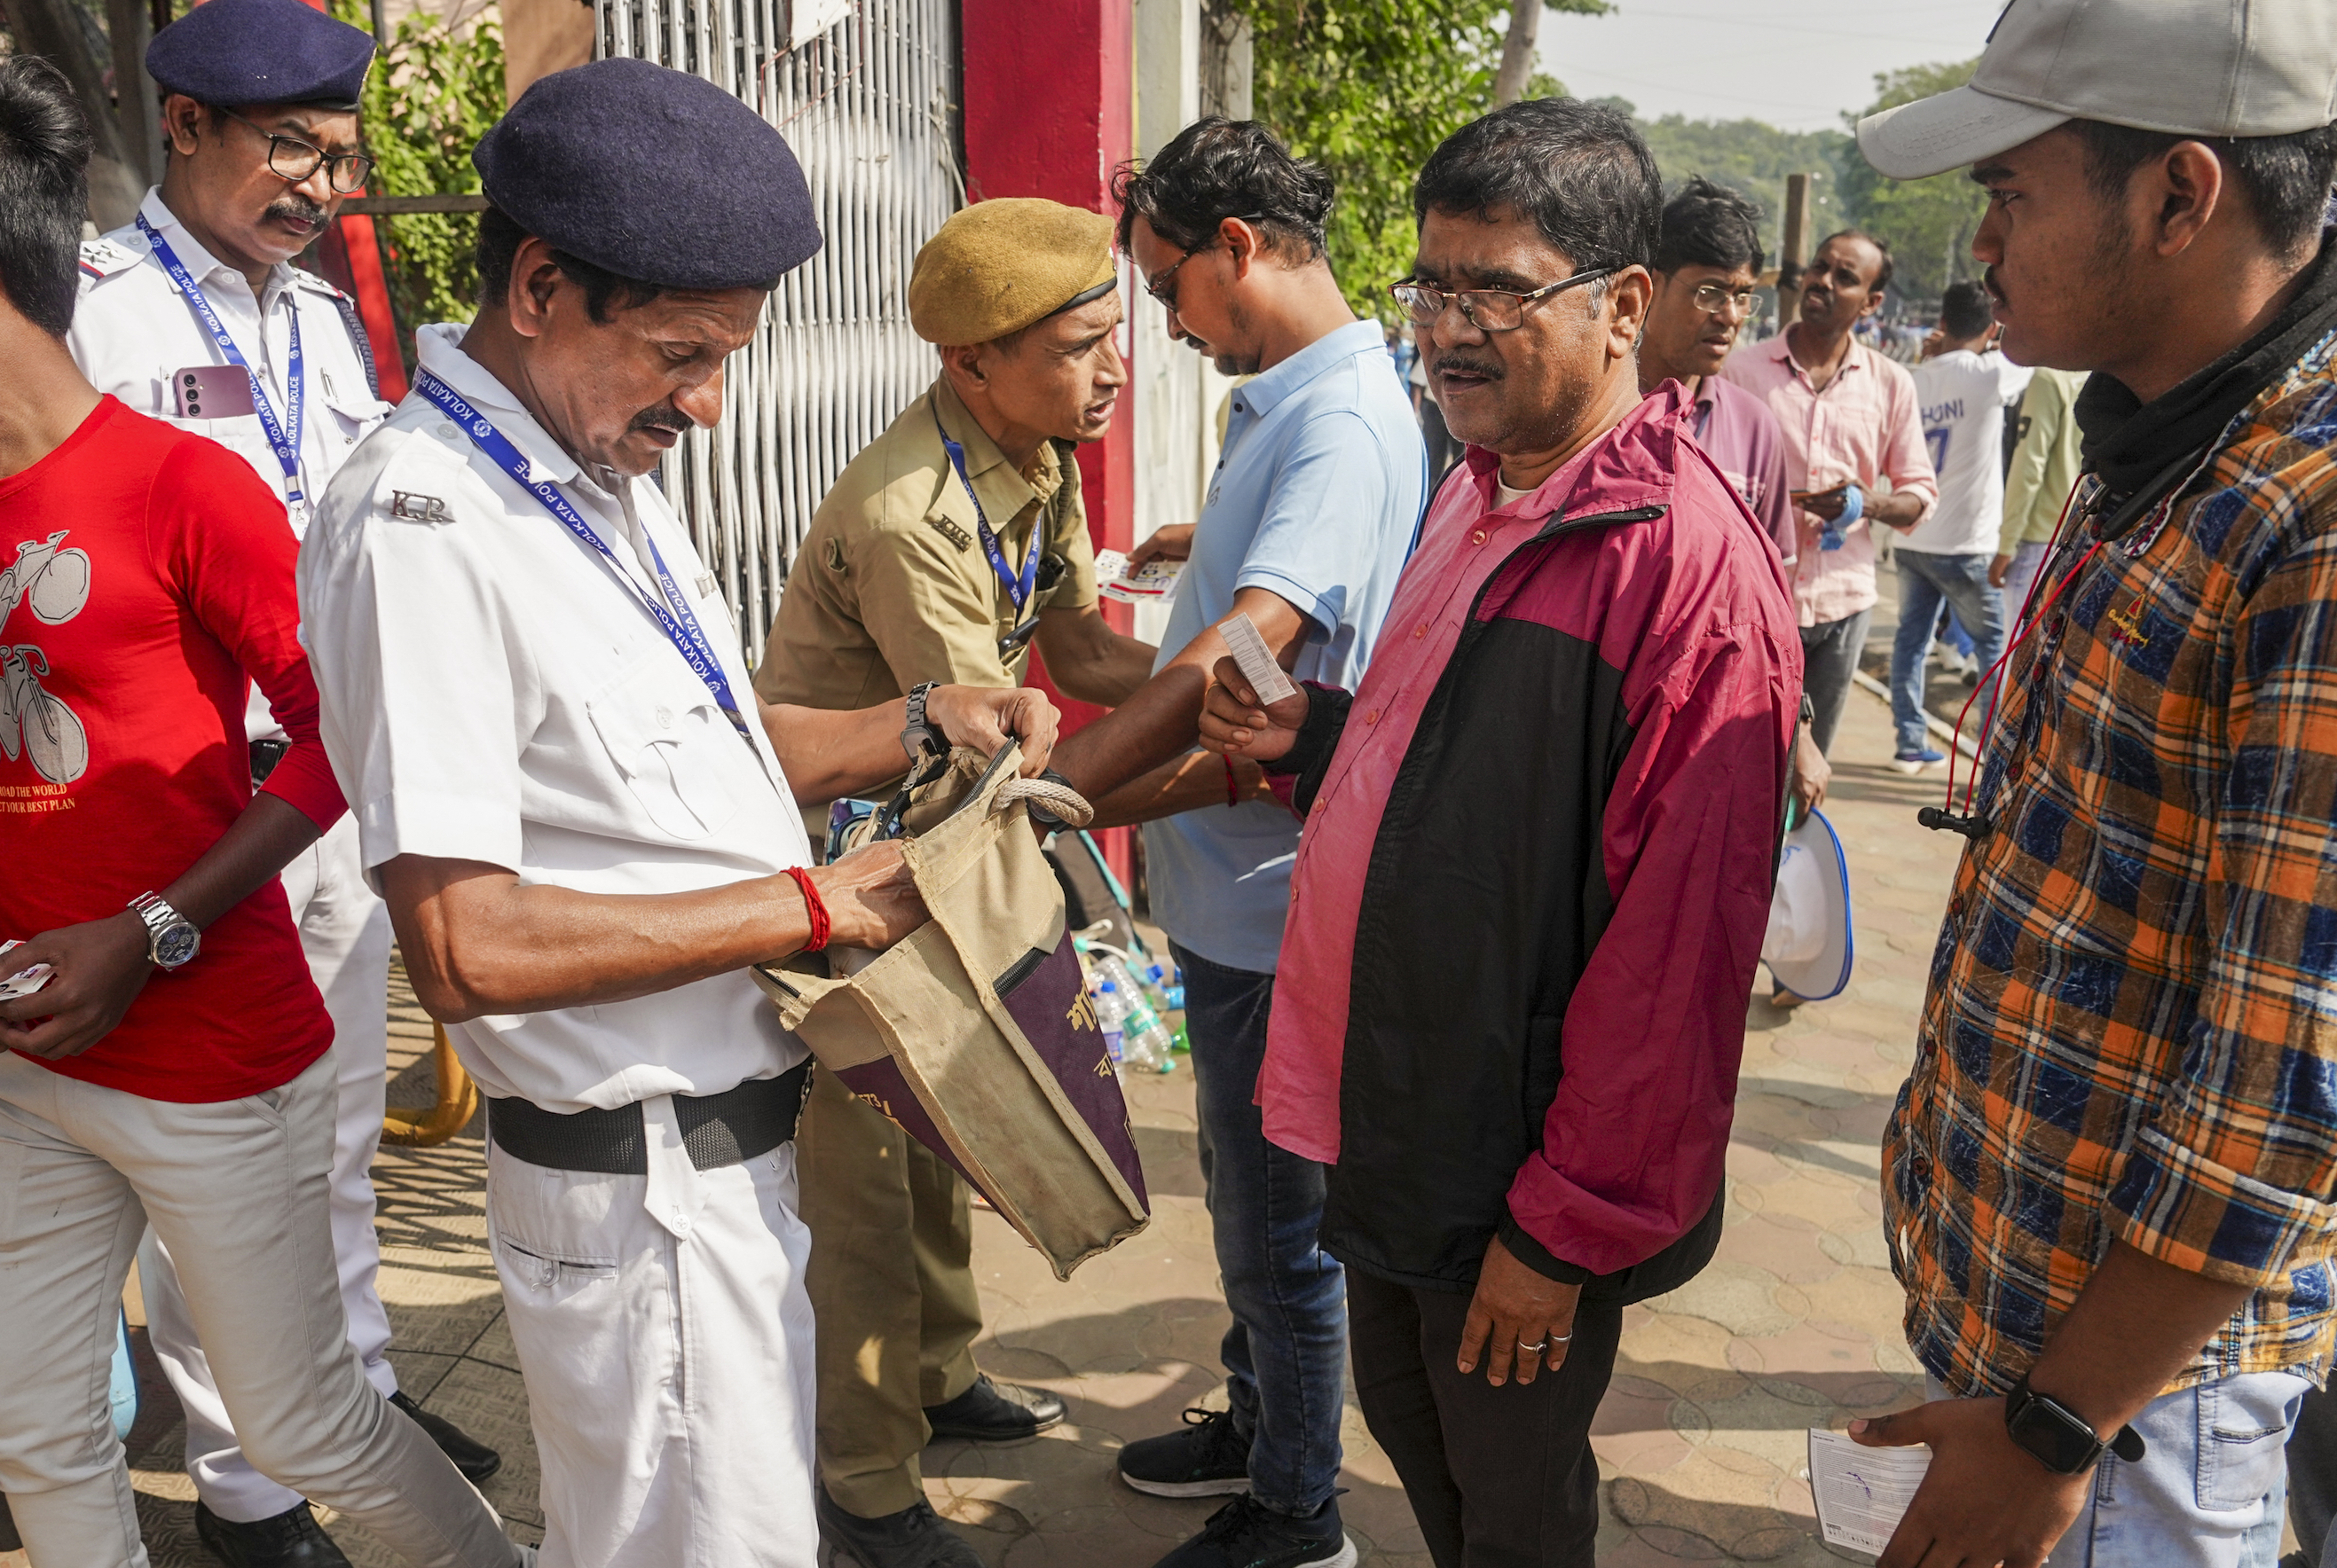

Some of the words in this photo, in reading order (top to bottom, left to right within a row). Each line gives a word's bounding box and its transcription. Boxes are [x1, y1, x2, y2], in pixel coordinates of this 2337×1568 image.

[170, 264, 197, 294] POLICE
[192, 293, 222, 333] KOLKATA
[289, 376, 299, 404] POLICE
[427, 379, 474, 421] KOLKATA
[258, 399, 283, 443] KOLKATA
[287, 405, 299, 445] KOLKATA
[1921, 398, 1964, 425] HONI
[1924, 425, 1951, 478] 7
[514, 461, 559, 503] POLCE
[556, 501, 605, 551] KOLKATA
[642, 590, 675, 632] POLICE
[659, 572, 689, 615] POLICE
[674, 628, 710, 680] KOLKATA
[6, 802, 26, 813] YOUR
[26, 800, 48, 813] BEST
[50, 798, 75, 811] PLAN
[16, 786, 32, 797] THE
[32, 784, 67, 796] WORLD
